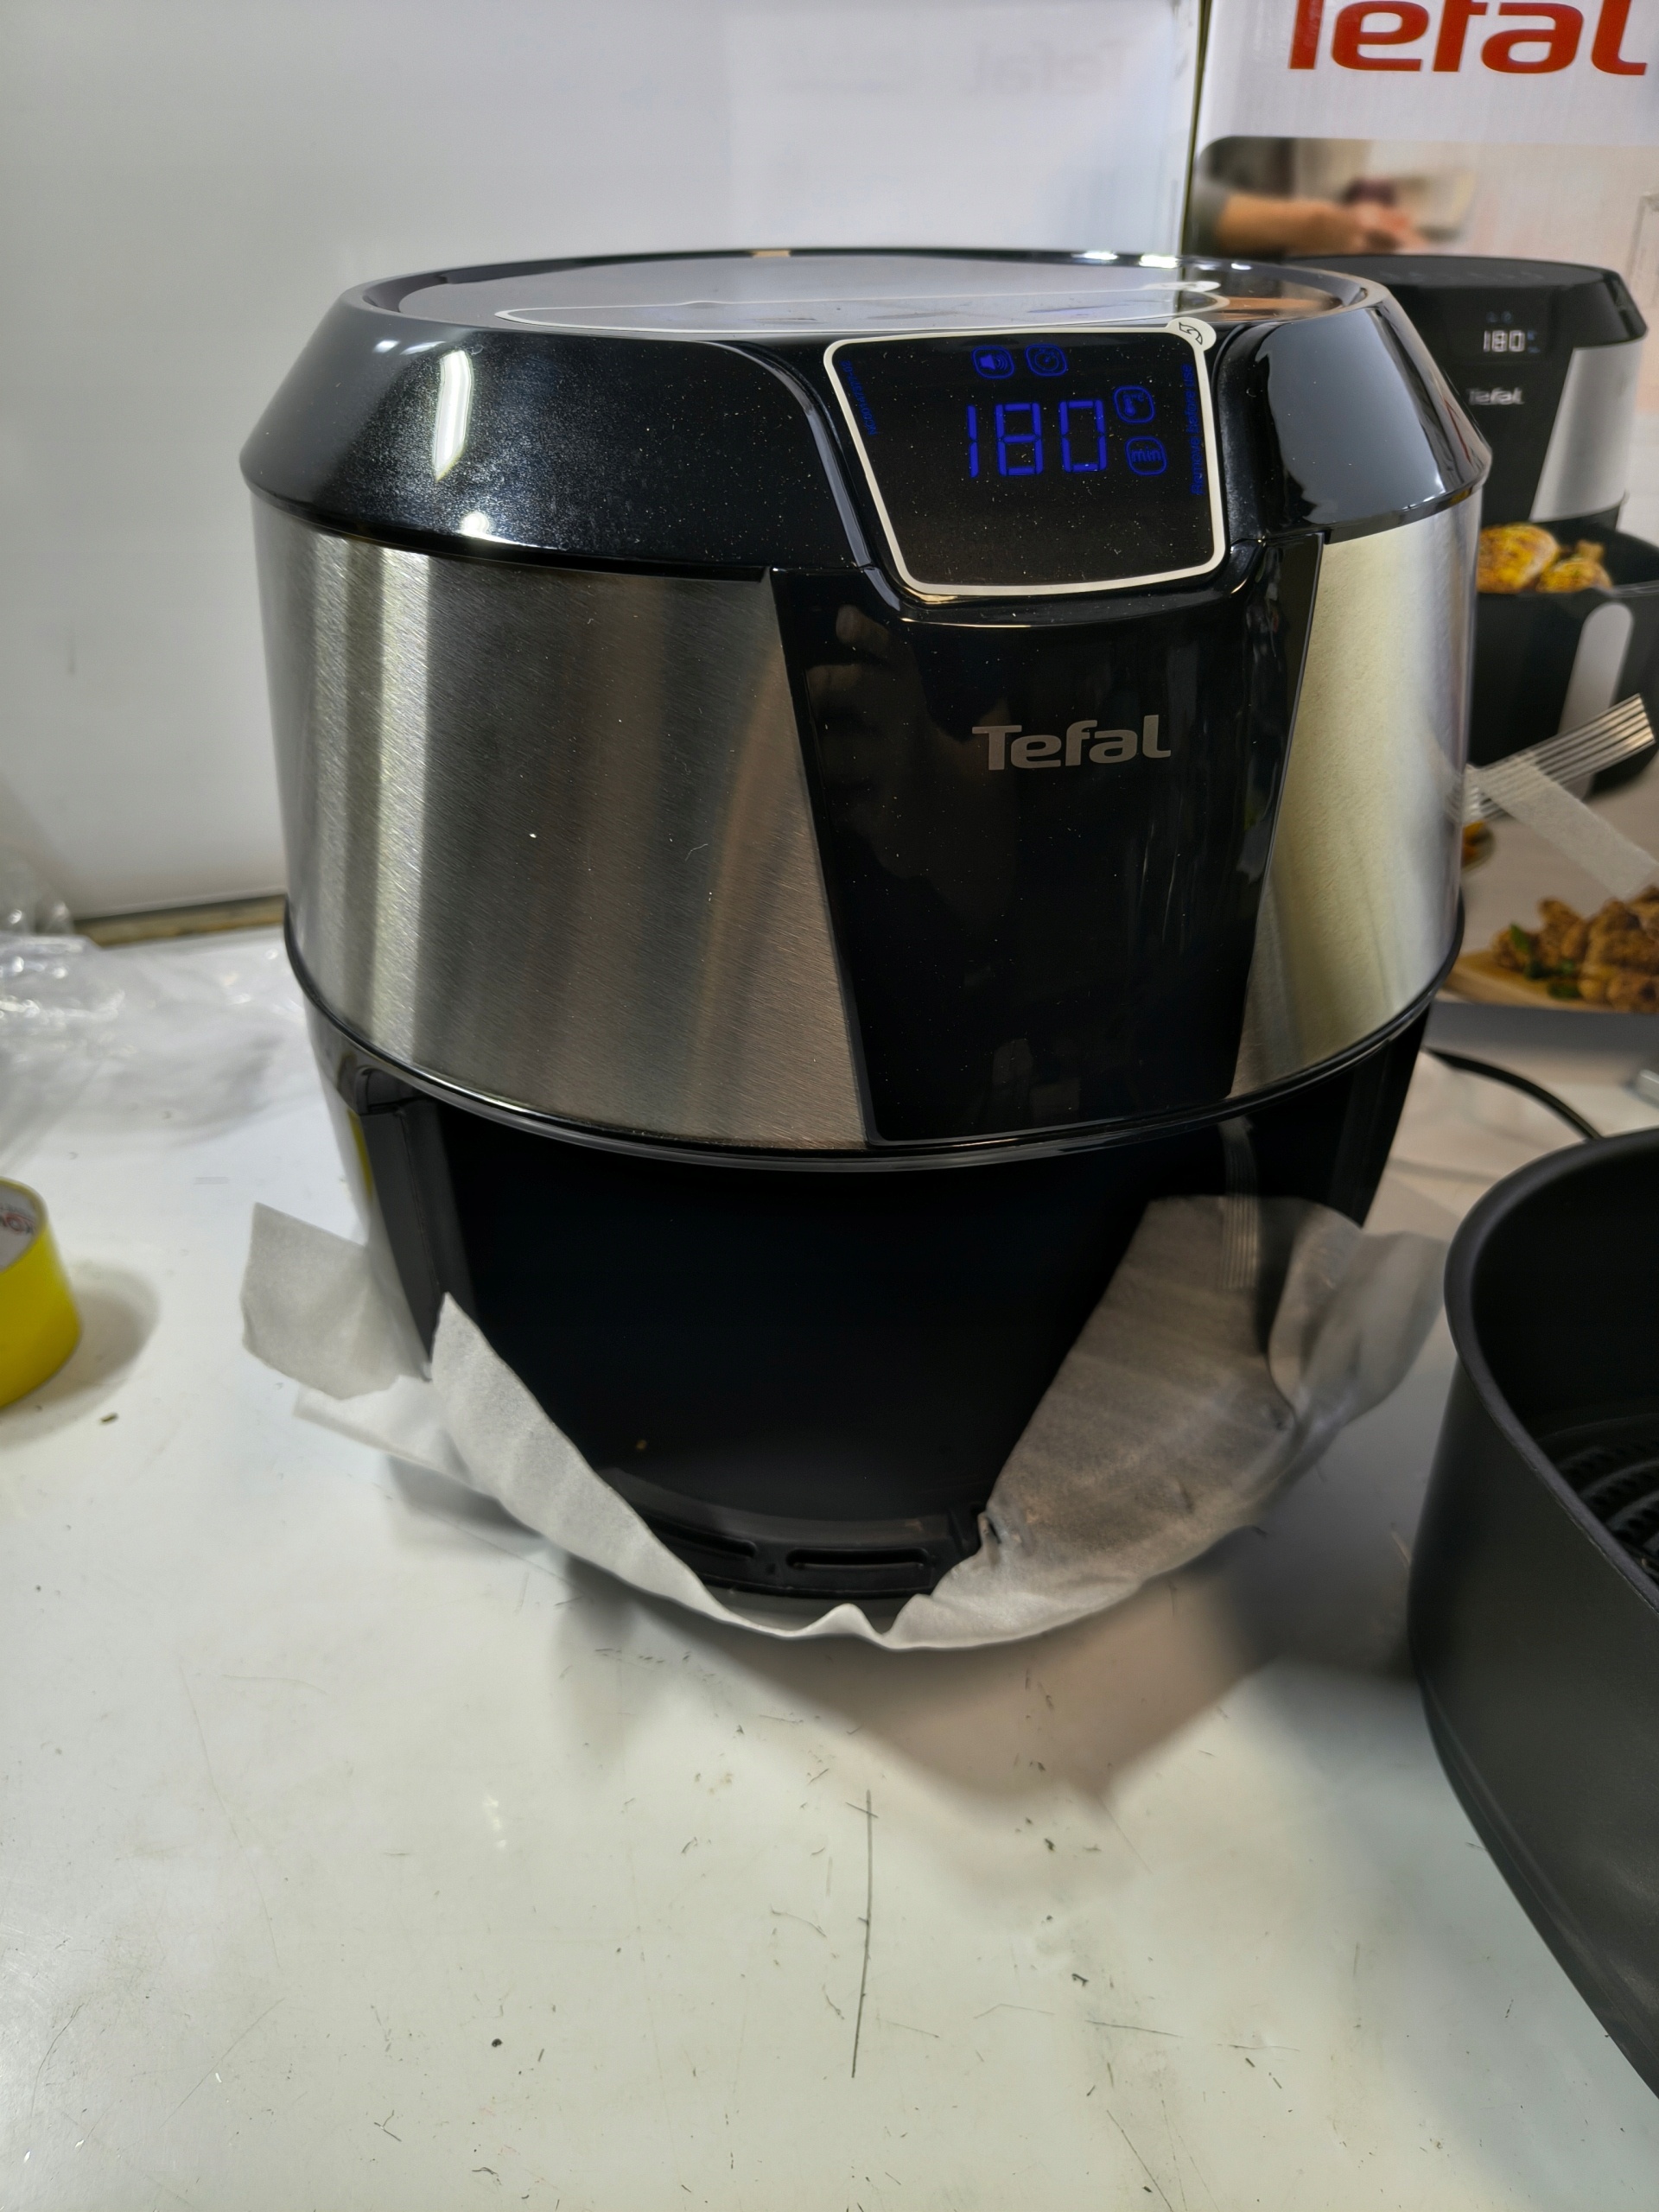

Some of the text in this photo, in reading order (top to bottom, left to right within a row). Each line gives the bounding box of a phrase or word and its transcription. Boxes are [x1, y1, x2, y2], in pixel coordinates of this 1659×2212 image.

[1484, 330, 1525, 353] 180
[967, 399, 1108, 478] 180
[1131, 446, 1162, 462] min
[1181, 364, 1205, 495] Remove before use
[972, 715, 1171, 770] Tefal
